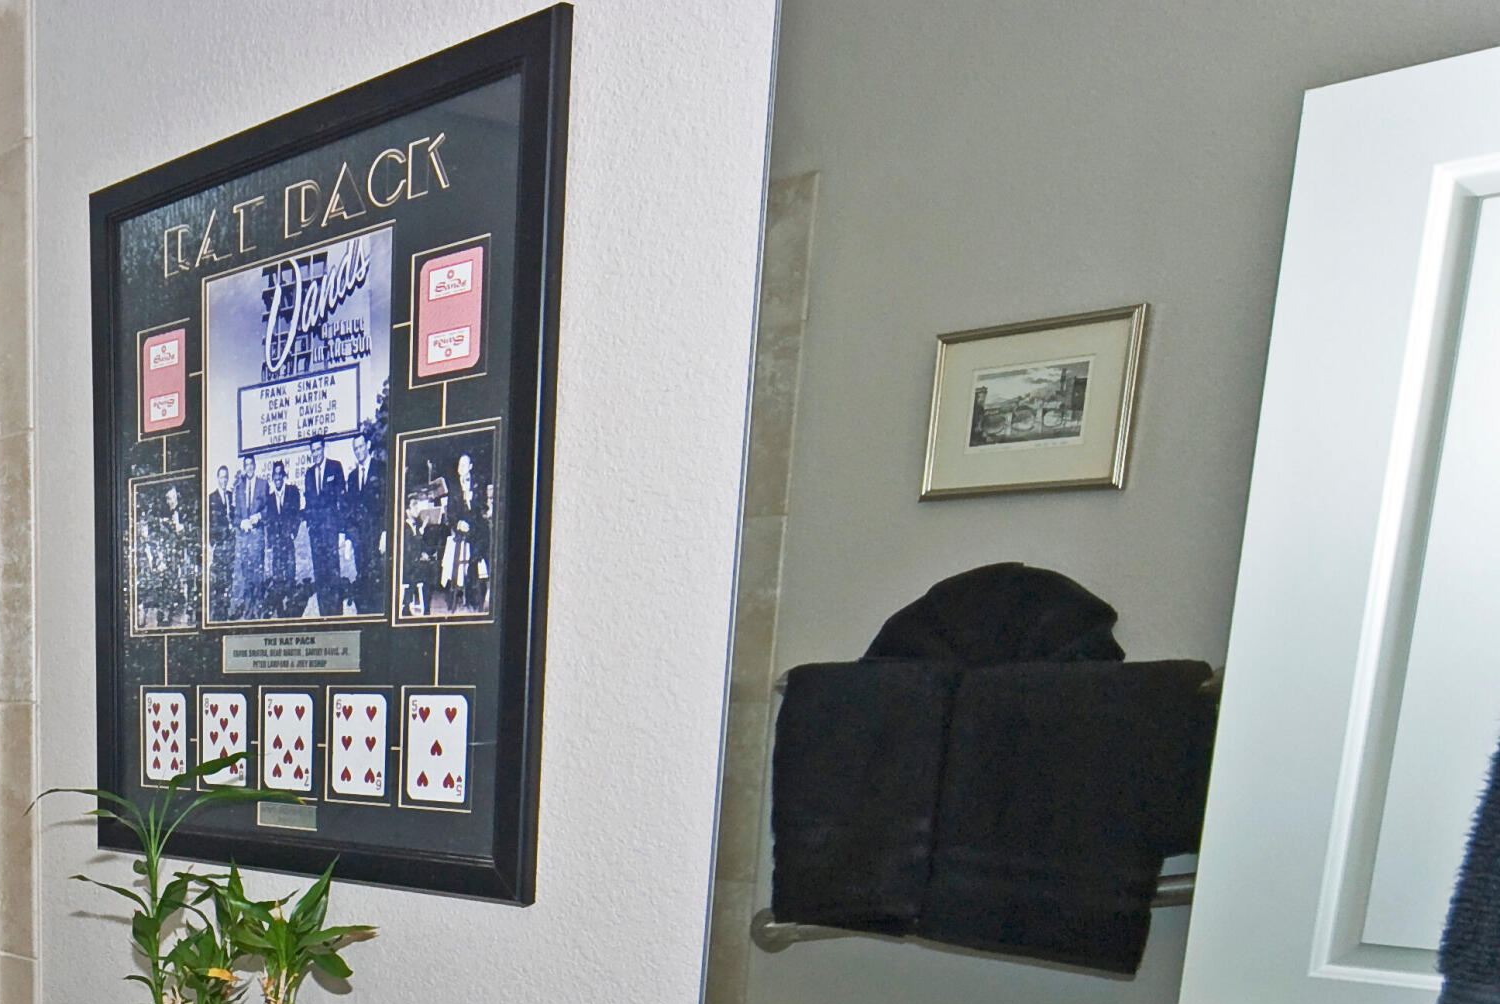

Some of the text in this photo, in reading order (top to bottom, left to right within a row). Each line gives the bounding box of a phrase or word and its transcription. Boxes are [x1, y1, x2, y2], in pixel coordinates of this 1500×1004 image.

[164, 133, 450, 279] RAT PACK
[260, 375, 336, 400] FRANK SINATRA
[269, 388, 328, 411] DEAN MARTIN
[261, 399, 337, 424] SAMMY DAVIS JR
[263, 412, 336, 436] PETER LAWFORD
[279, 637, 293, 646] RAT
[295, 636, 316, 645] PACK
[267, 698, 273, 709] 7
[335, 698, 342, 711] 6
[411, 699, 418, 712] 5
[456, 784, 463, 797] 5
